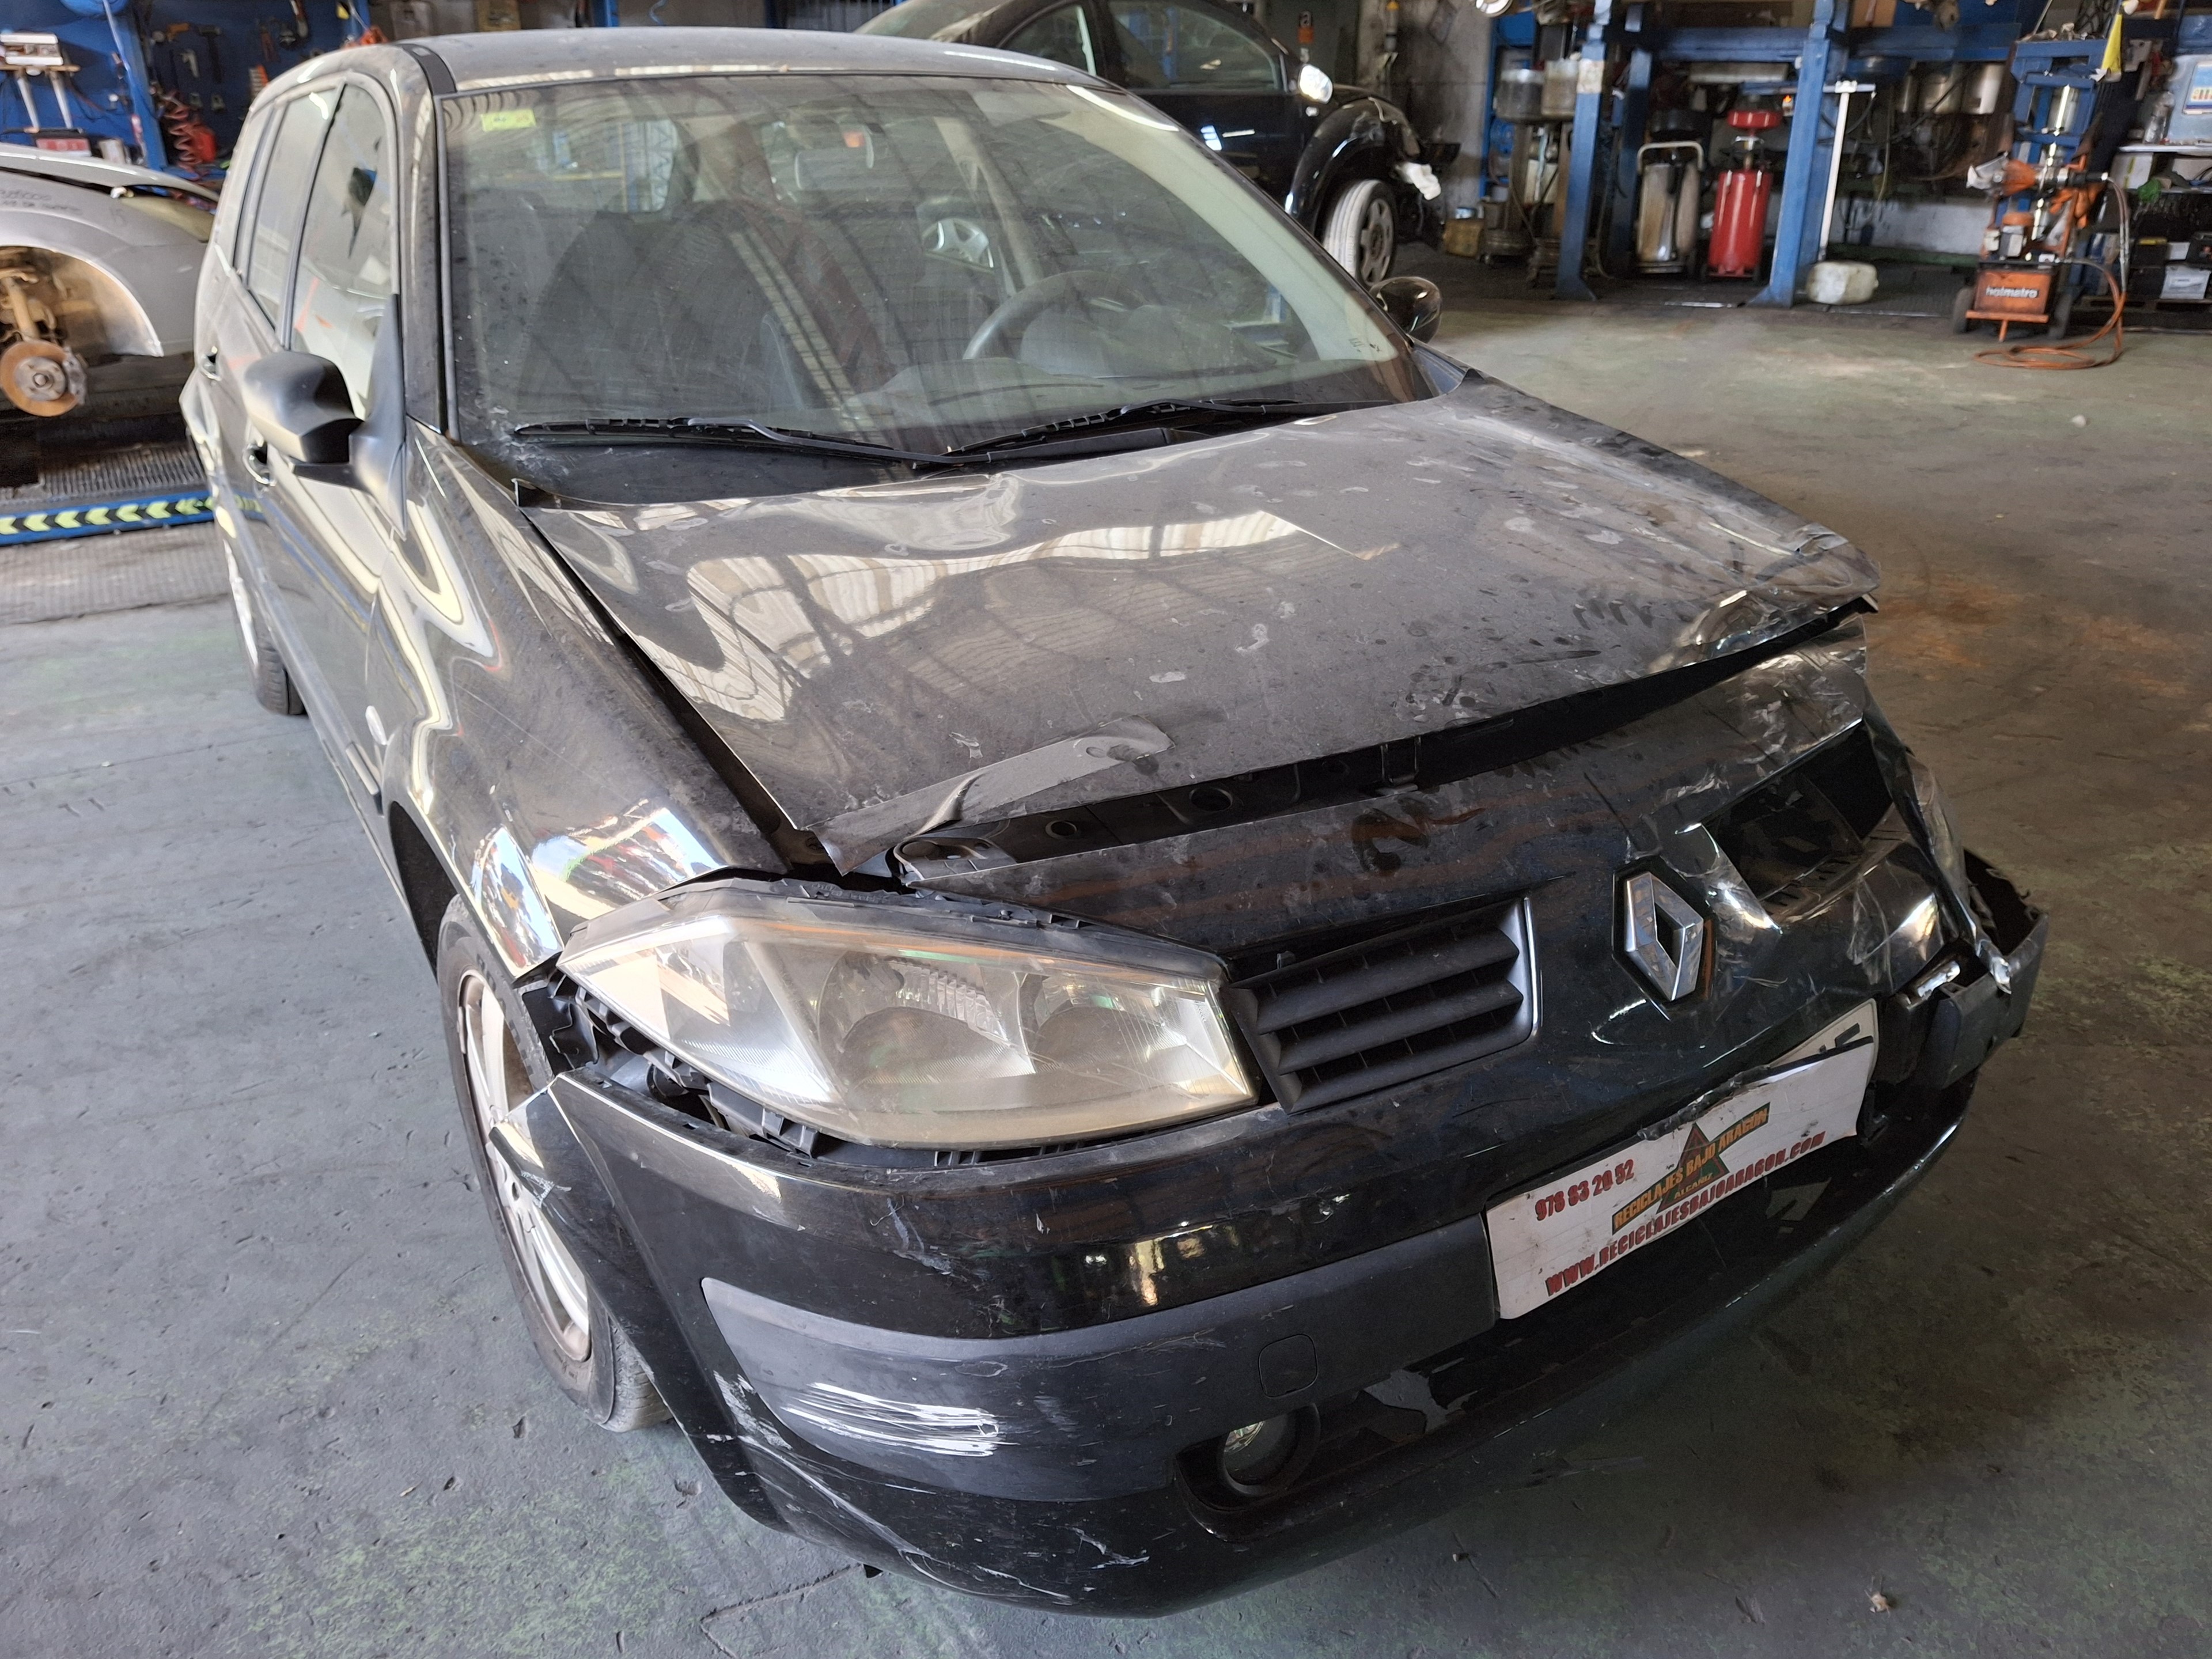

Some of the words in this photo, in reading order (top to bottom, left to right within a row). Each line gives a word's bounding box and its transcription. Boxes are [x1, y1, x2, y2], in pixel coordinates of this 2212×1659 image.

[1535, 1191, 1565, 1221] 978
[1567, 1180, 1590, 1206] 83
[1592, 1170, 1613, 1196] 20
[1615, 1159, 1634, 1185] 52
[1545, 1131, 1826, 1297] WWW.RECICLAJESBAJOARAGON.COM
[1614, 1167, 1683, 1229] RECICLAJES
[1686, 1142, 1715, 1177] BAJO
